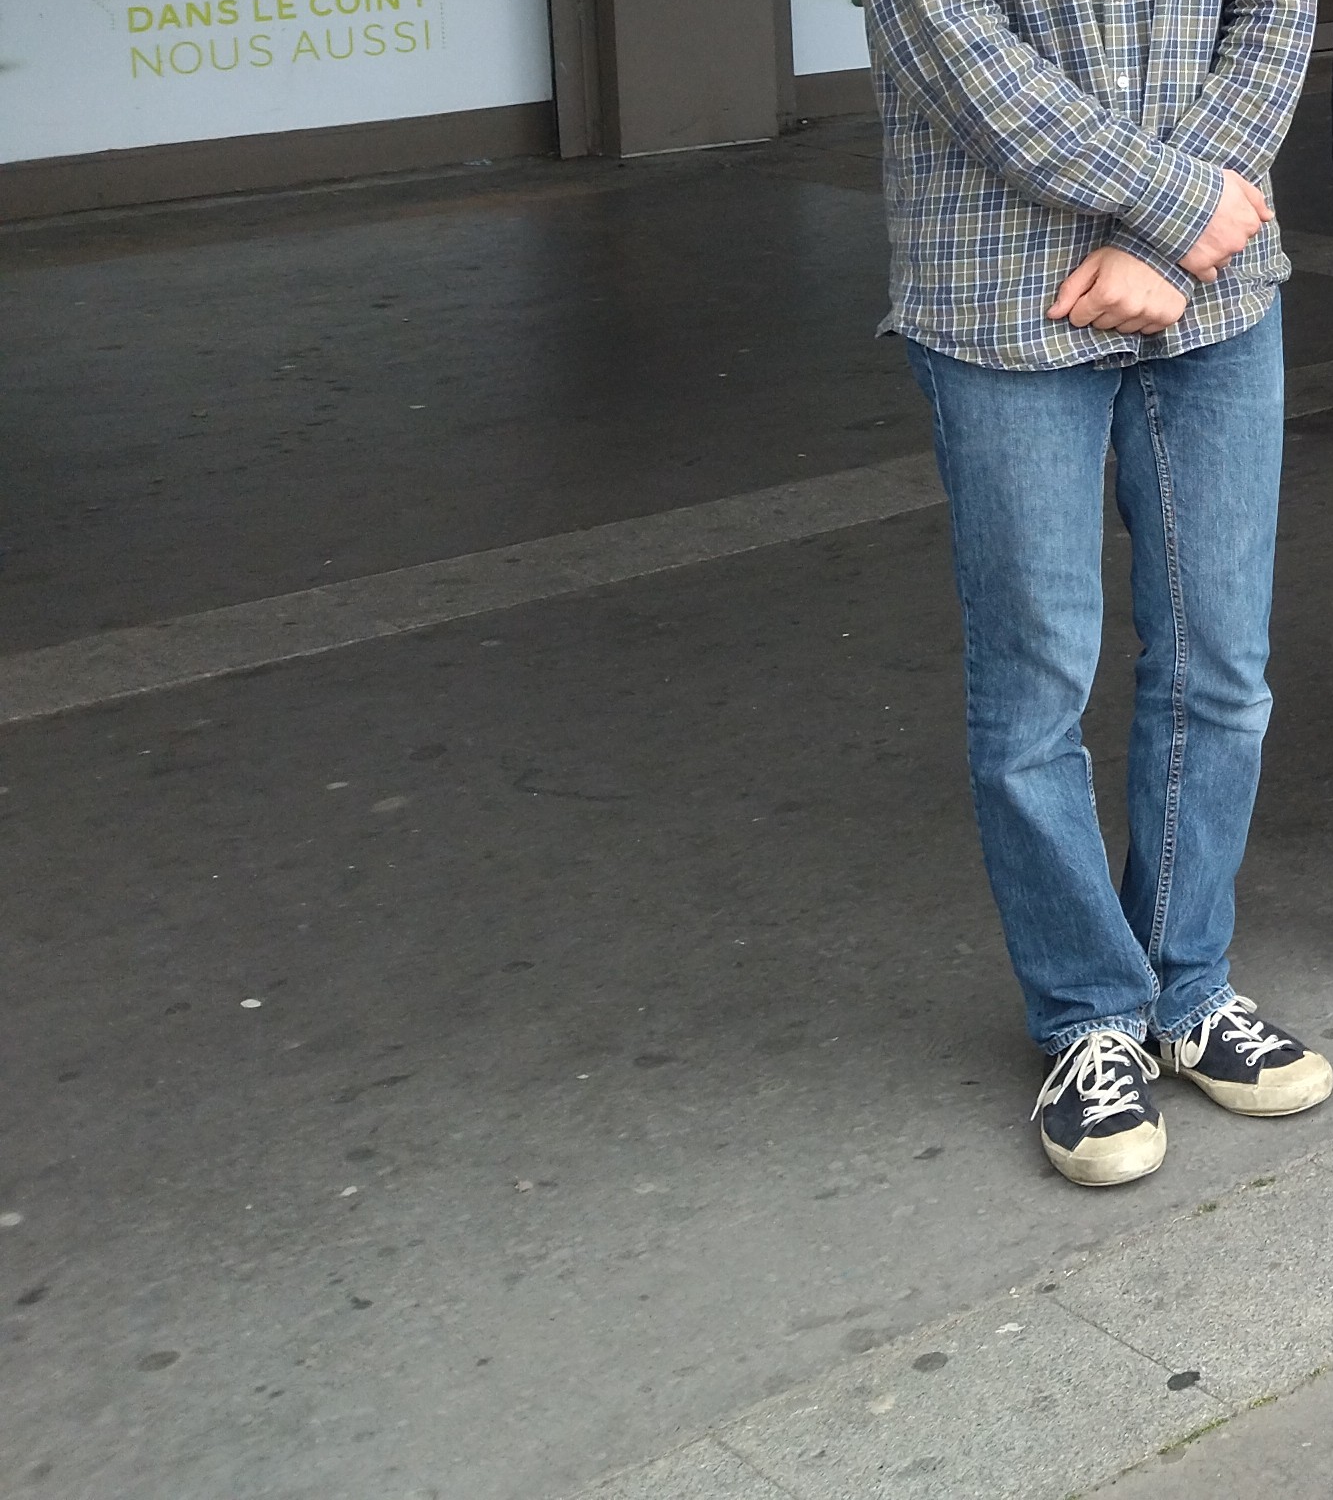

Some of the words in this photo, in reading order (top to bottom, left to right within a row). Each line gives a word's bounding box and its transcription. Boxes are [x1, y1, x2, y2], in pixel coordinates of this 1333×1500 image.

[127, 0, 239, 33] DANS
[130, 34, 273, 79] NOUS
[292, 19, 431, 63] AUSSI
